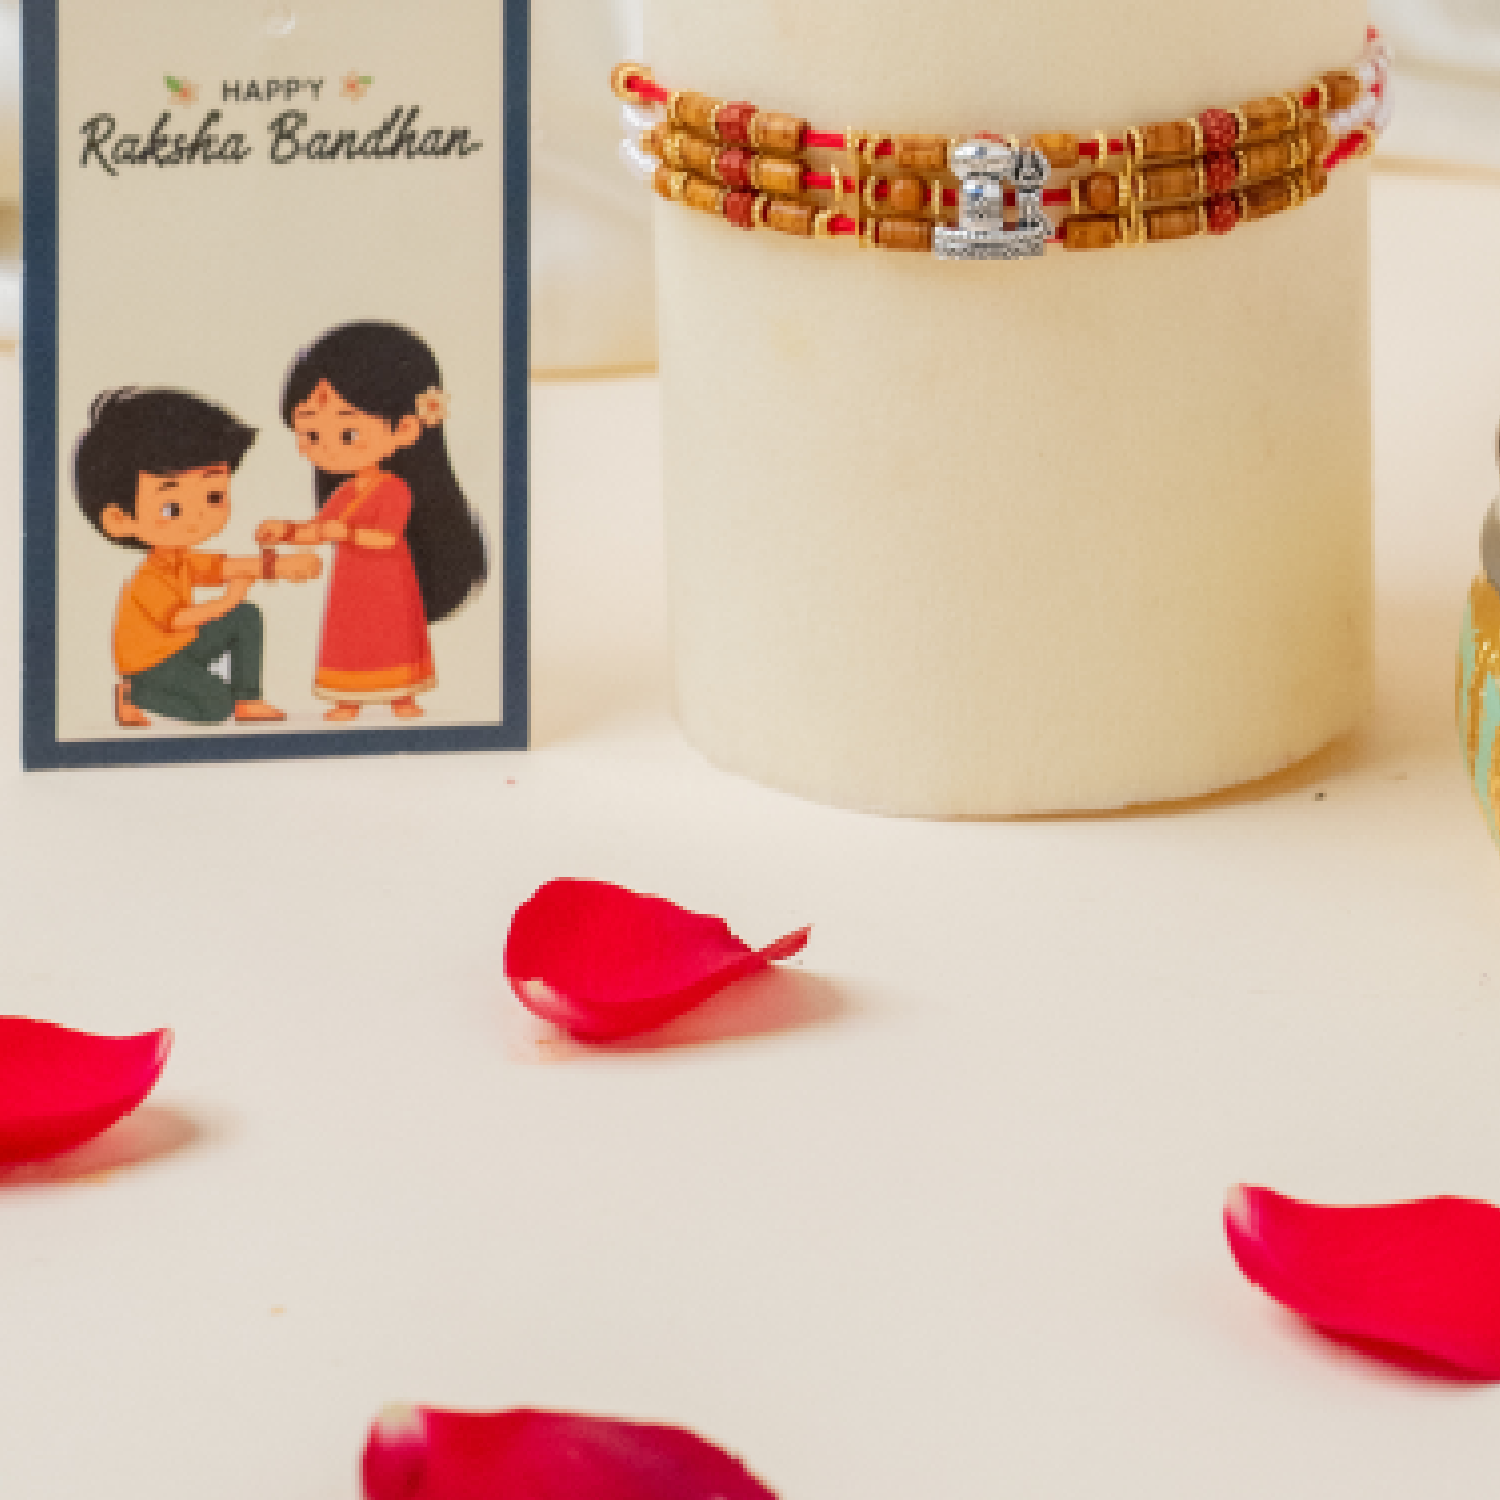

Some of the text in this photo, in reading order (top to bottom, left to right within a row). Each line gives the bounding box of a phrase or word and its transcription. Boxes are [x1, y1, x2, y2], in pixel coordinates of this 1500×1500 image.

[222, 78, 325, 102] HAPPY
[79, 105, 484, 176] Raksha Bandhan
